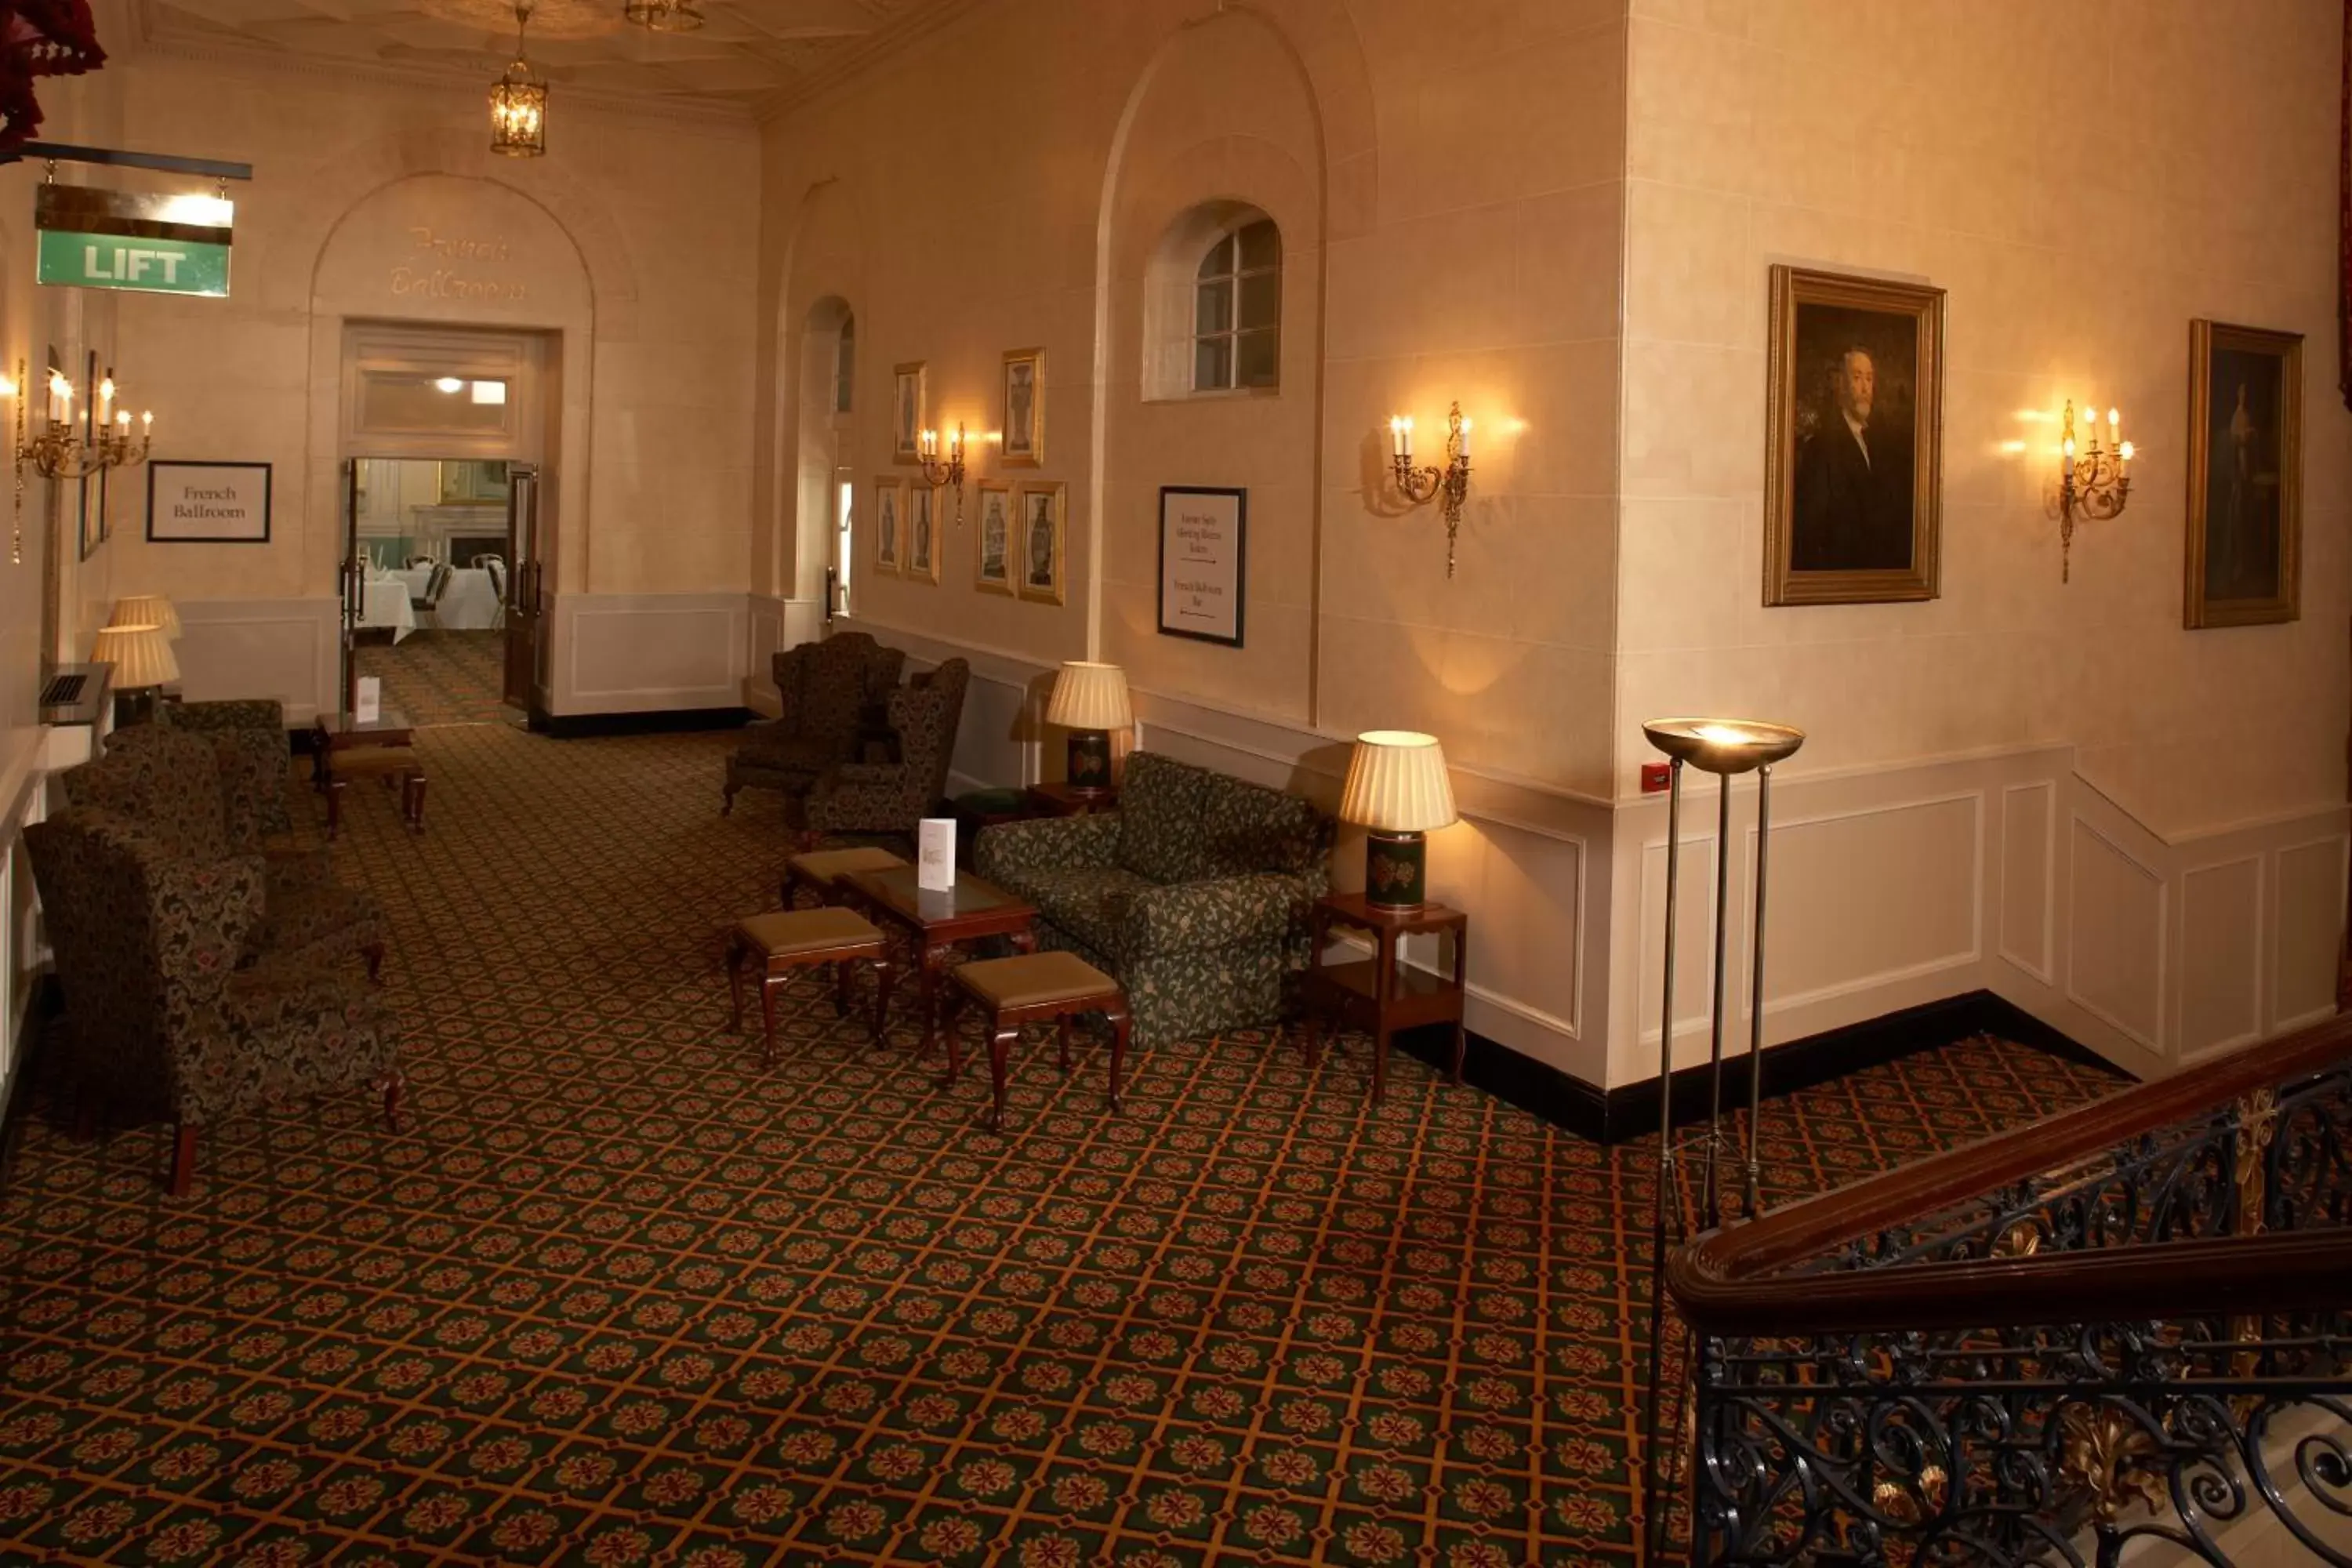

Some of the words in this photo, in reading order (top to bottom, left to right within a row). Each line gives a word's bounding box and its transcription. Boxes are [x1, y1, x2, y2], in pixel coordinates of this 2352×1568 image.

[84, 245, 186, 284] LIFT
[184, 486, 236, 501] French
[174, 504, 245, 517] Ballroom
